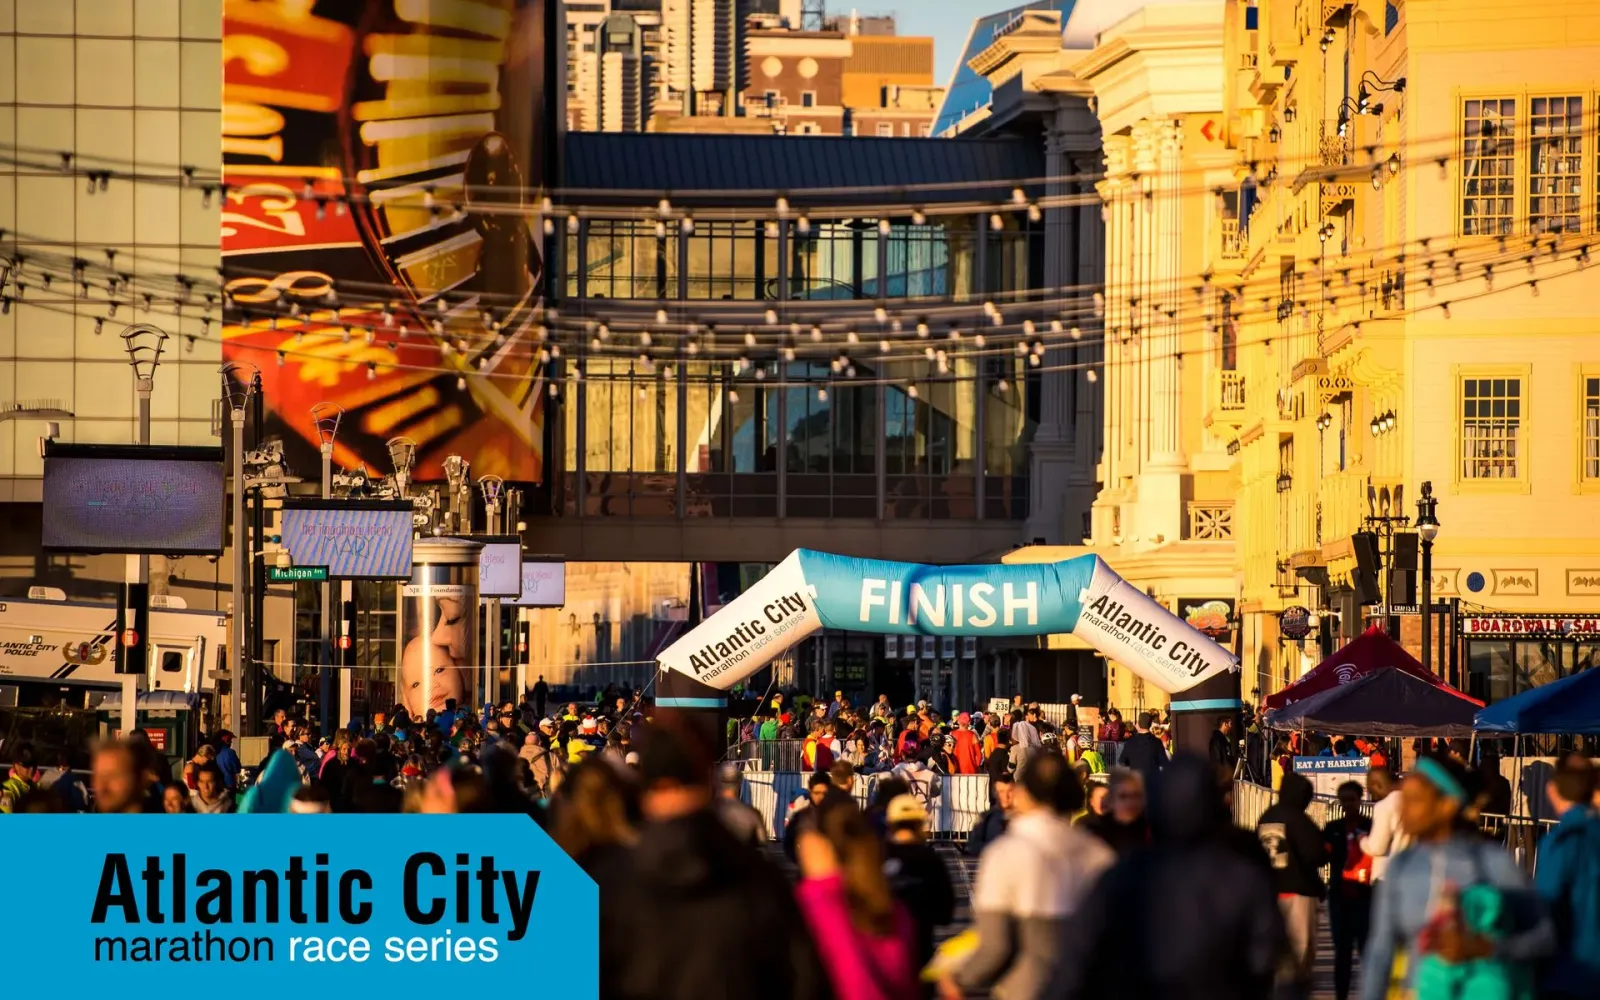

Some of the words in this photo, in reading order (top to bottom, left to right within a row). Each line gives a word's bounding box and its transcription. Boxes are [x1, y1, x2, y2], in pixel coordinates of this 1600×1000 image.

[321, 535, 375, 558] MARY
[275, 568, 312, 580] Michigan
[859, 578, 1039, 628] FINISH
[689, 619, 766, 675] Atlantic
[763, 591, 808, 625] City
[1089, 594, 1168, 650] Atlantic
[1168, 641, 1211, 677] City
[1470, 618, 1564, 633] BOARDWALK
[4, 648, 39, 657] POLICE
[36, 644, 59, 652] CITY
[701, 648, 750, 683] marathon
[750, 633, 773, 652] race
[773, 613, 805, 636] series
[1081, 611, 1131, 645] marathon
[1131, 641, 1156, 659] race
[1156, 656, 1187, 679] series
